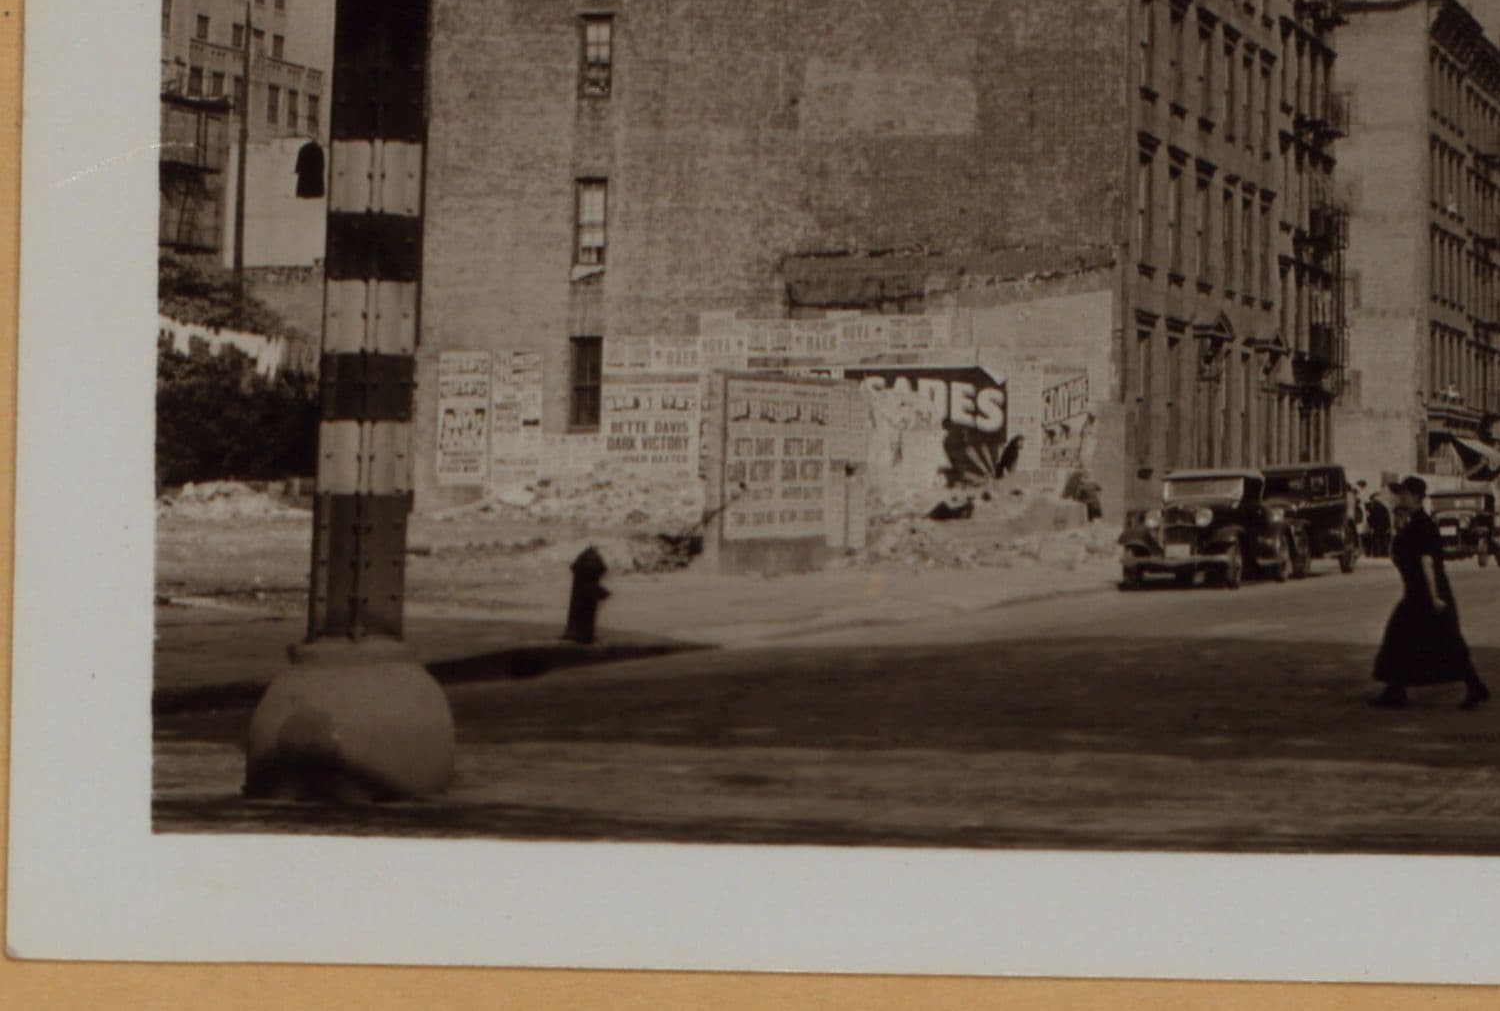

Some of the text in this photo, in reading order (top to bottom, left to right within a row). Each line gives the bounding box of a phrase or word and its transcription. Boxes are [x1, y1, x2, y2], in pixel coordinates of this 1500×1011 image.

[610, 420, 689, 434] BETTE DAVIS
[606, 436, 690, 451] DARK VICTORY
